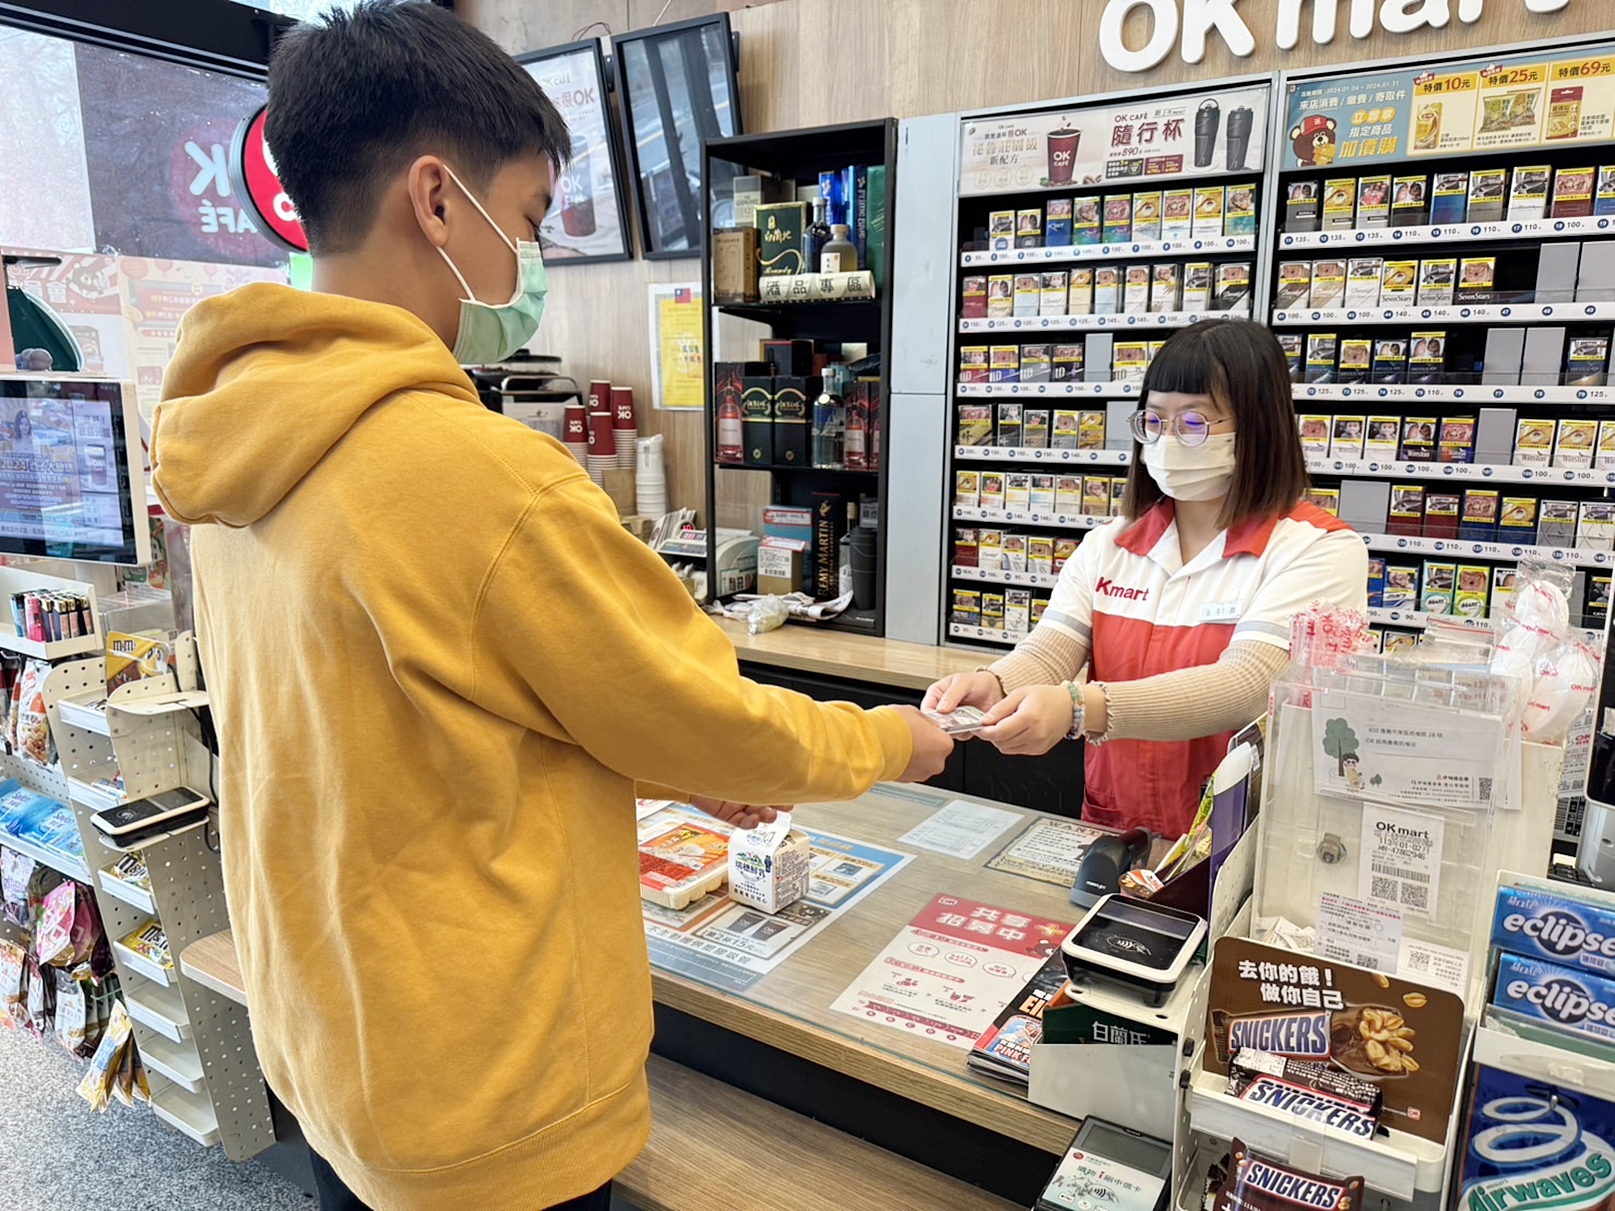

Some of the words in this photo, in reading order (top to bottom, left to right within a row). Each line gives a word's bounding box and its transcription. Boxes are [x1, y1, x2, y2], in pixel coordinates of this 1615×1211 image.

[1099, 0, 1255, 73] OK
[1276, 0, 1573, 50] ma
[1488, 69, 1538, 85] 特價25元
[1558, 61, 1611, 77] 特價69元
[1423, 77, 1471, 93] 特價10元
[1114, 114, 1128, 123] OK
[1111, 118, 1185, 147] 隨行杯
[1349, 123, 1393, 138] 指定商品
[1053, 151, 1071, 161] OK
[1339, 136, 1399, 158] 加價購
[990, 154, 1019, 165] 新配方
[618, 411, 632, 420] OK
[569, 425, 583, 433] OK
[817, 519, 829, 563] MARTIN
[817, 567, 829, 596] REMY
[1095, 577, 1150, 601] Kmart
[1376, 821, 1396, 834] OK
[1398, 827, 1430, 839] mart
[1503, 914, 1615, 957] eclipse
[1238, 960, 1333, 988] 去你的餓！
[1260, 983, 1344, 1010] 做你自己
[1092, 1021, 1148, 1045] 白蘭氏
[1231, 1013, 1327, 1054] SNICKERS
[994, 1042, 1020, 1060] PINK
[1250, 1082, 1376, 1137] SNICKERS
[1247, 1163, 1340, 1209] SNICKERS
